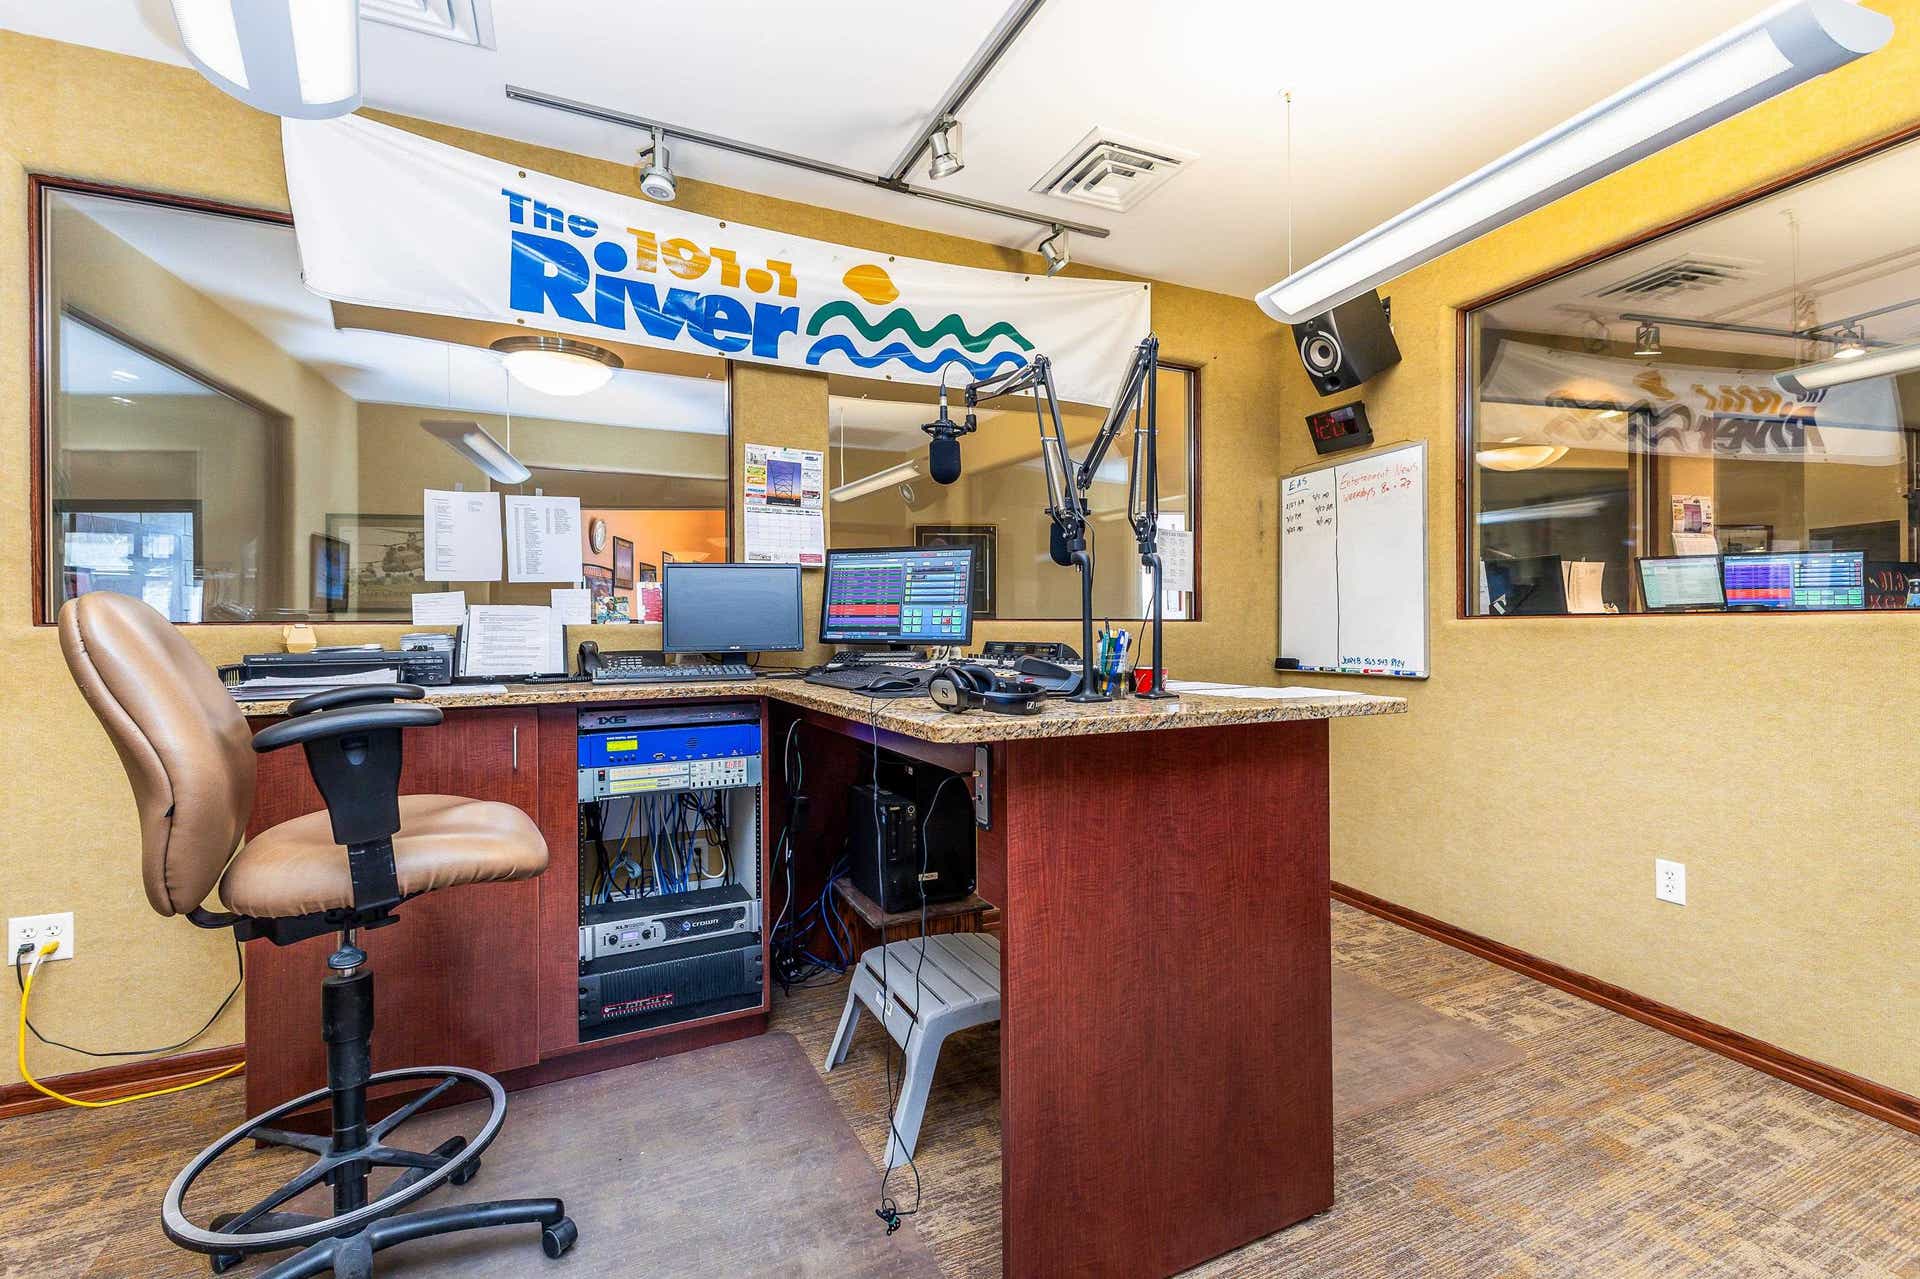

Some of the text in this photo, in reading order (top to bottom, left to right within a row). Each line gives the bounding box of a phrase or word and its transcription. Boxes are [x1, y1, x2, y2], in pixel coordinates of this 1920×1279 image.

[502, 188, 599, 238] The
[626, 227, 797, 298] 101.1
[510, 230, 800, 359] River
[692, 918, 719, 928] crown
